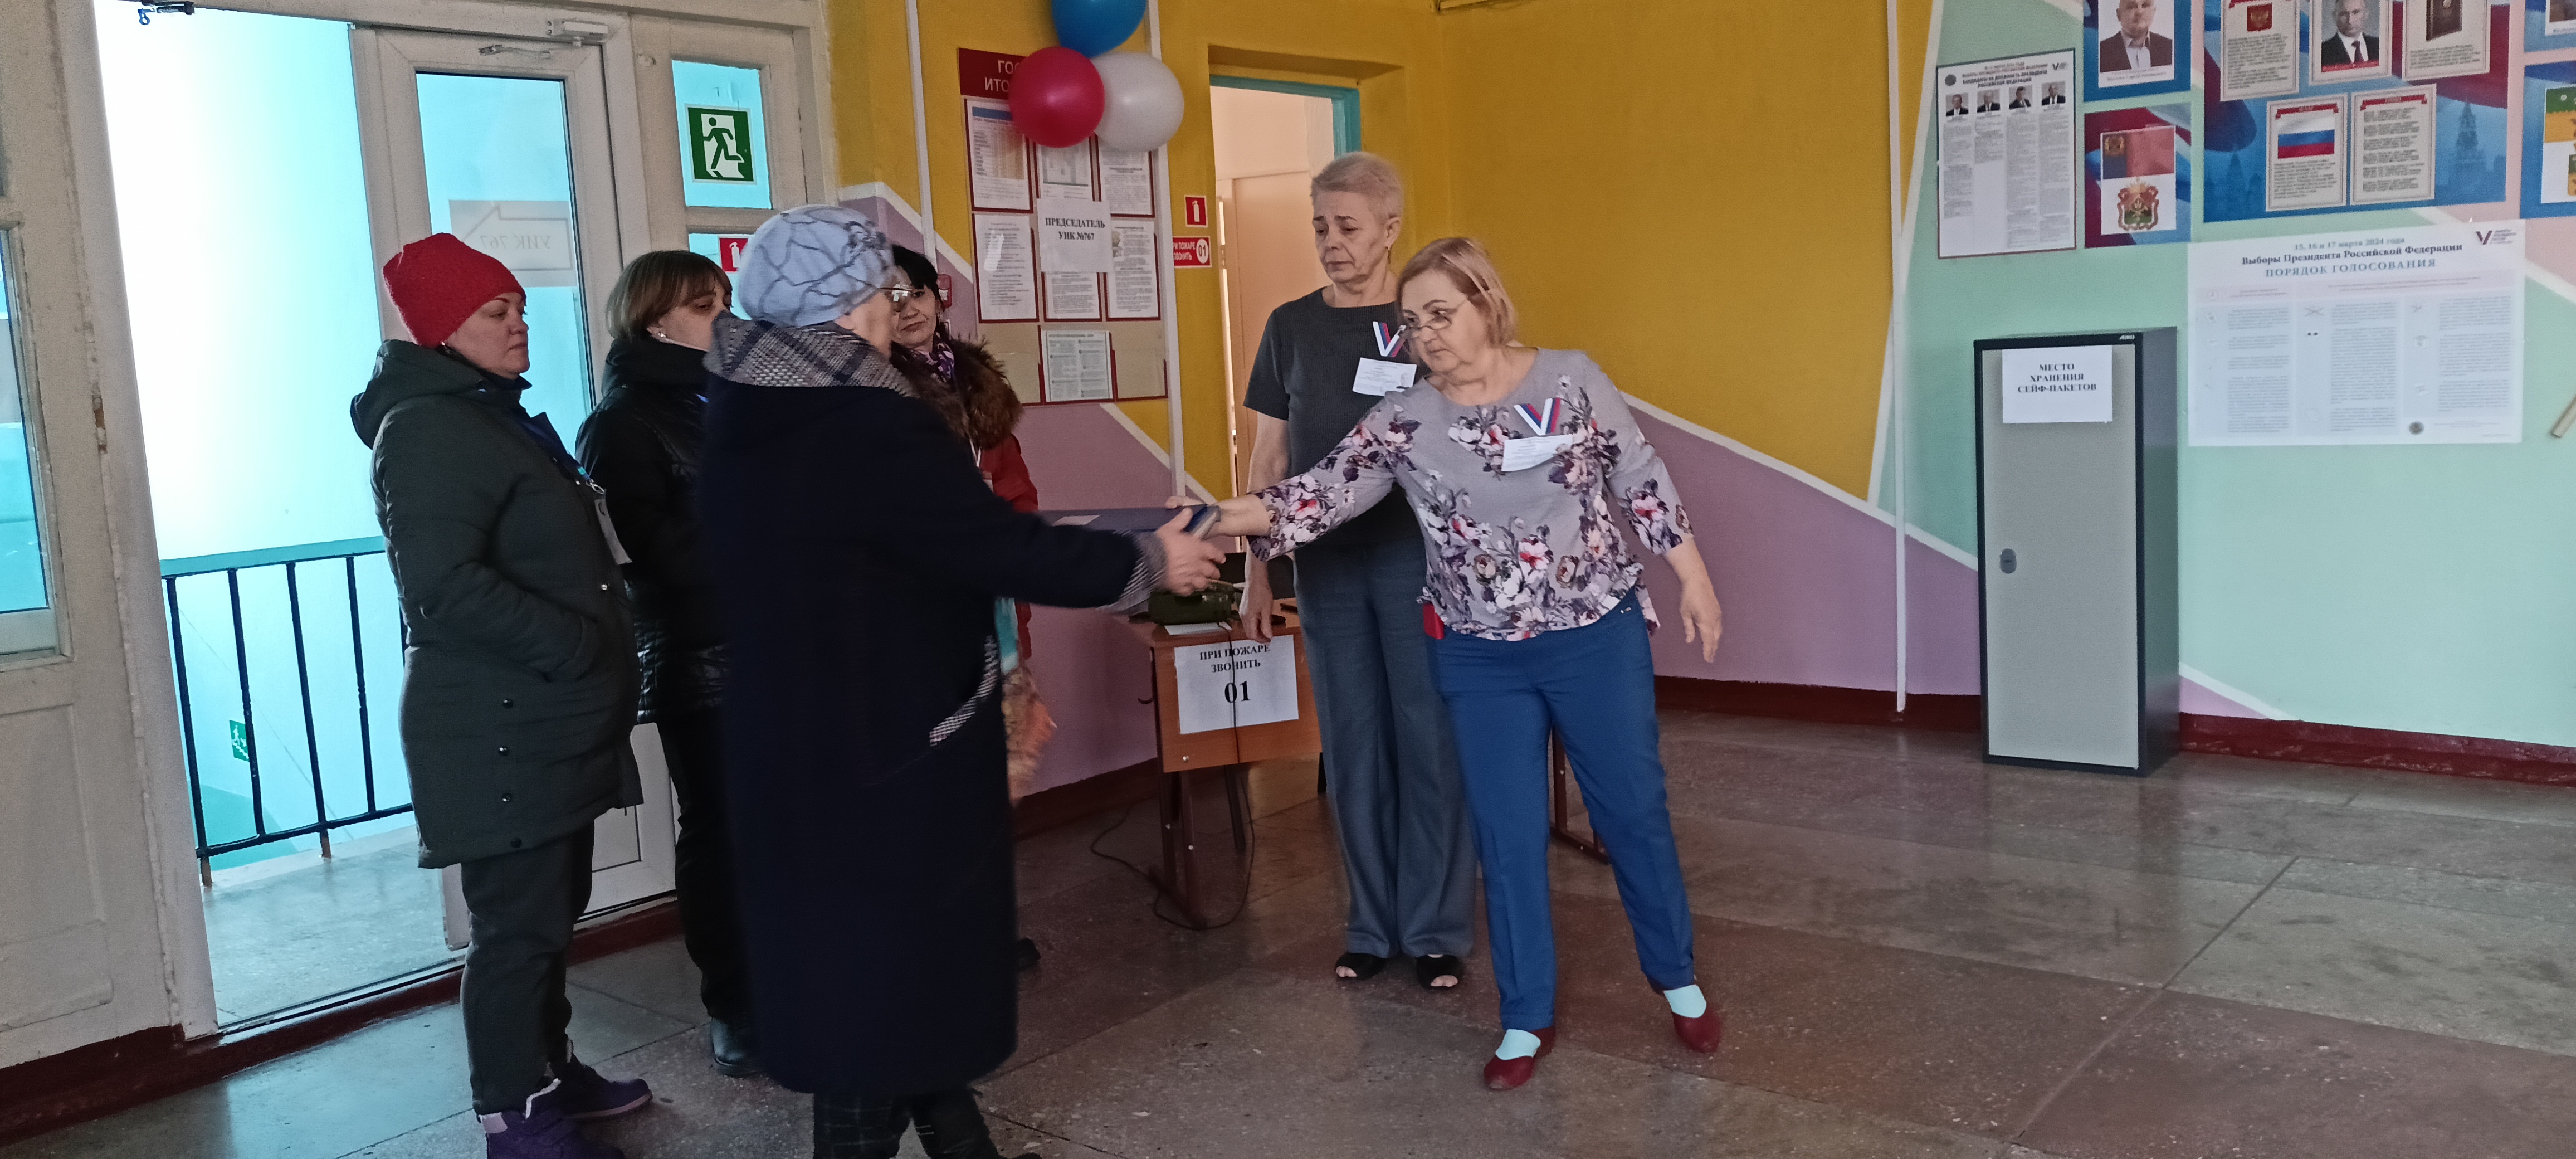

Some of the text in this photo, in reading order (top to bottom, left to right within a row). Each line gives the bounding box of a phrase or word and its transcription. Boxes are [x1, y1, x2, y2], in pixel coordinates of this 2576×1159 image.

[1045, 217, 1105, 228] ПРЕДСЕДАТЕЛЬ
[1058, 231, 1095, 240] УИК №767
[1198, 245, 1207, 257] 01
[2242, 244, 2462, 265] Выборы Президента Российской Федерации
[2266, 259, 2436, 277] ПОРЯДОК ГОЛОСОВАНИЯ
[2029, 373, 2084, 382] ХРАНЕНИЯ
[2018, 383, 2097, 393] СЕЙФ-ПАКЕТОВ
[1199, 644, 1271, 661] ПРИ ПОЖАРЕ
[1211, 659, 1261, 673] ЗВОНИТЬ
[1224, 680, 1251, 703] 01
